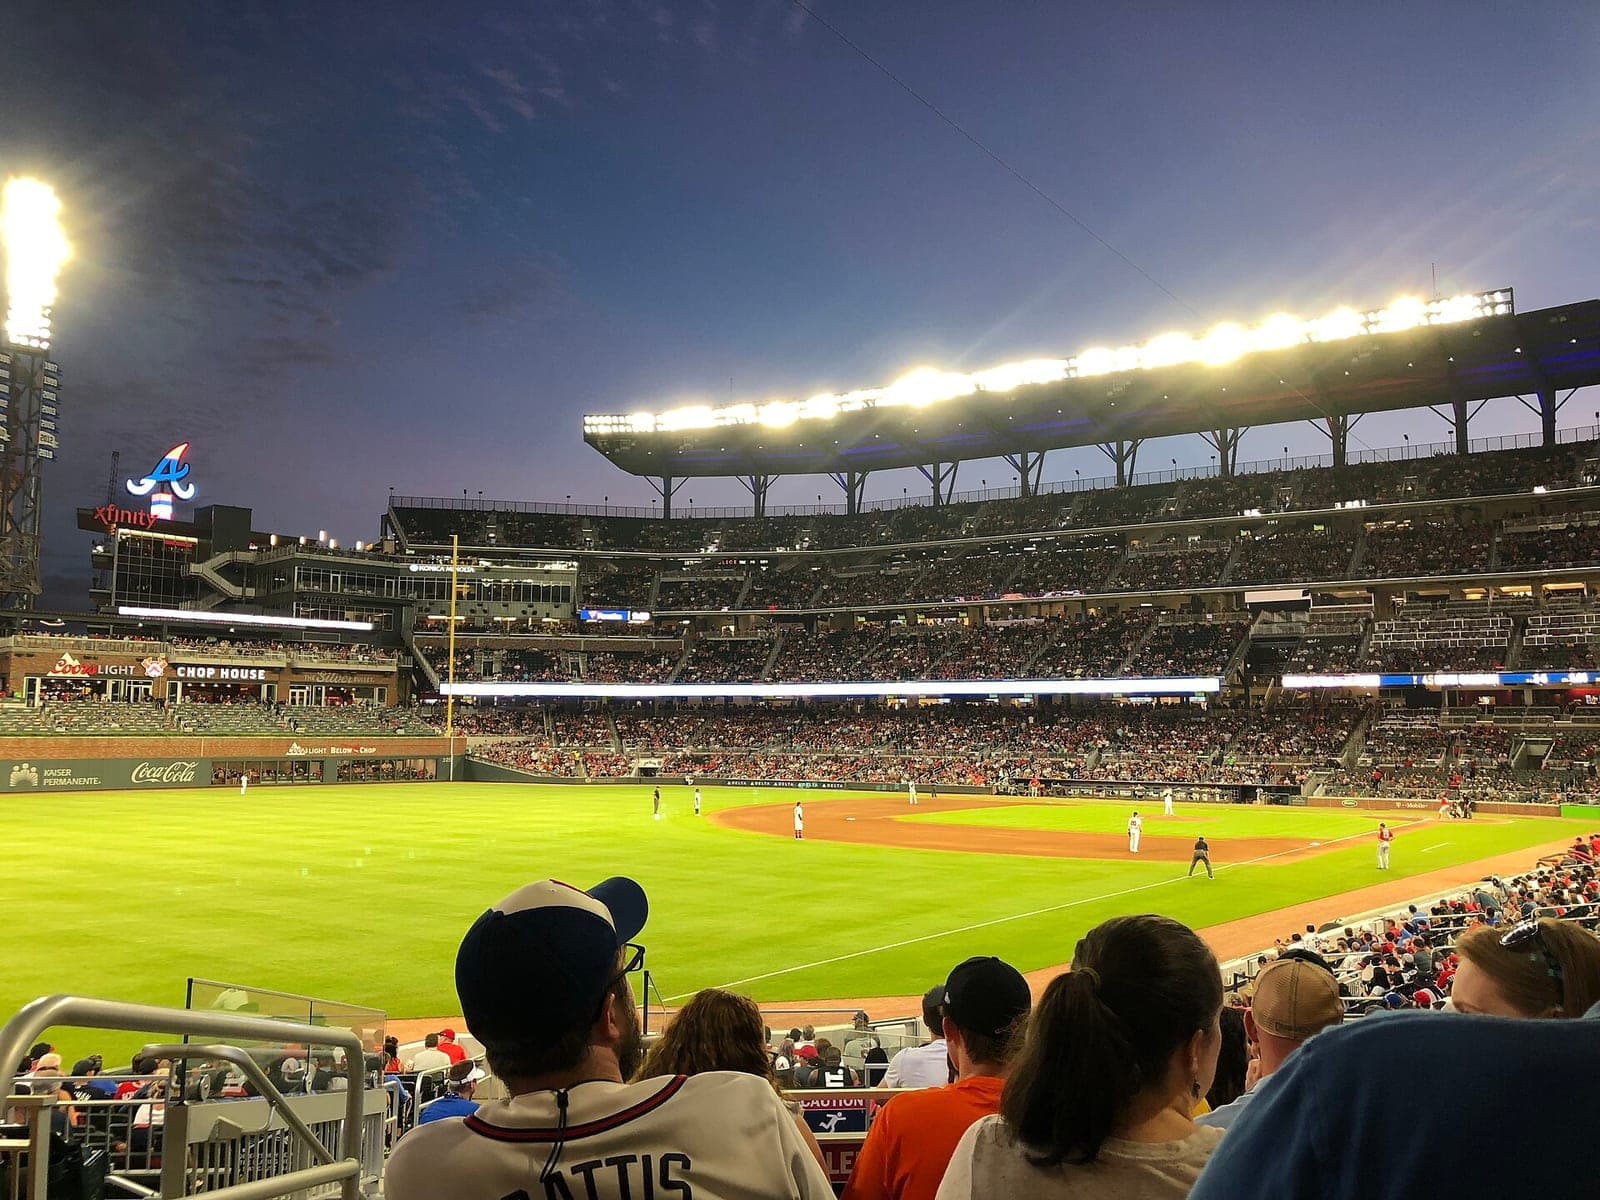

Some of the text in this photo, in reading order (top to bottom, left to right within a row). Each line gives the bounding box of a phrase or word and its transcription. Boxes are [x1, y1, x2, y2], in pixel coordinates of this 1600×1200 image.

[93, 503, 159, 529] xfinity
[51, 659, 136, 675] Coors LIGHT
[177, 666, 265, 680] CHOP HOUSE
[44, 769, 72, 777] KAISER
[131, 761, 199, 783] Coca-Cola
[43, 778, 99, 786] PERMANENTE
[501, 1153, 692, 1200] ATTIS
